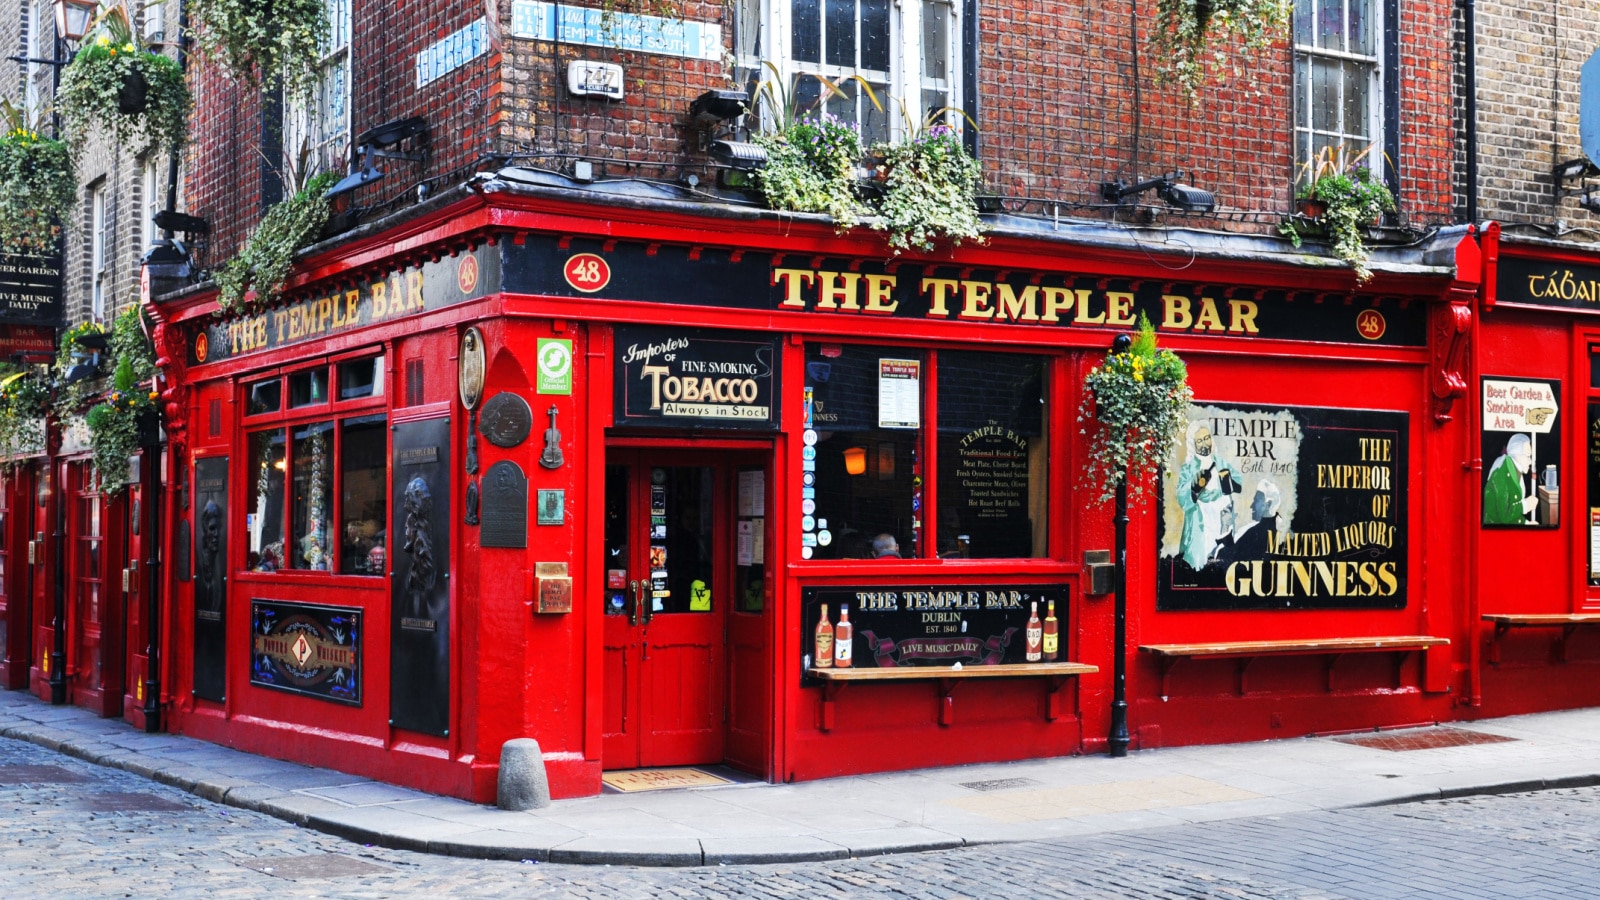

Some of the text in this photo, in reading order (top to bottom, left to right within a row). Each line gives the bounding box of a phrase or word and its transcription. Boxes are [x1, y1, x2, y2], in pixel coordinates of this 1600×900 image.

[647, 37, 690, 52] SOUTH
[705, 33, 715, 51] 2
[18, 266, 59, 276] GARDEN
[461, 261, 475, 289] 48
[572, 257, 600, 283] 48
[9, 301, 39, 310] DAILY
[20, 294, 54, 303] MUSIC
[773, 268, 1259, 333] THE TEMPLE BAR
[229, 272, 424, 354] THE TEMPLE BAR
[1360, 313, 1380, 333] 48
[622, 337, 689, 365] Importers
[664, 353, 676, 362] OF
[682, 360, 757, 375] FINE SMOKING
[640, 365, 758, 410] TOBACCO
[1486, 384, 1507, 398] Beer
[1509, 386, 1543, 400] Garden
[665, 403, 767, 417] Always in Stock
[813, 413, 838, 421] INNESS
[1486, 400, 1524, 417] Smoking
[1208, 417, 1297, 439] TEMPLE
[1494, 417, 1516, 429] Area
[960, 426, 1027, 450] TEMPLE BAR
[1235, 439, 1276, 460] BAR
[1359, 438, 1391, 462] THE
[1317, 464, 1391, 490] EMPEROR
[1372, 494, 1391, 518] OF
[1265, 520, 1397, 557] MALTED LIQUORS
[1225, 560, 1398, 597] GUINNESS
[856, 590, 1023, 611] THE TEMPLE BAR
[922, 612, 961, 623] DUBLIN
[925, 624, 957, 633] EST. 1840
[264, 639, 288, 655] POWERS
[316, 644, 347, 663] WHISKEY
[902, 643, 979, 654] LIVE MUSIC DAILY
